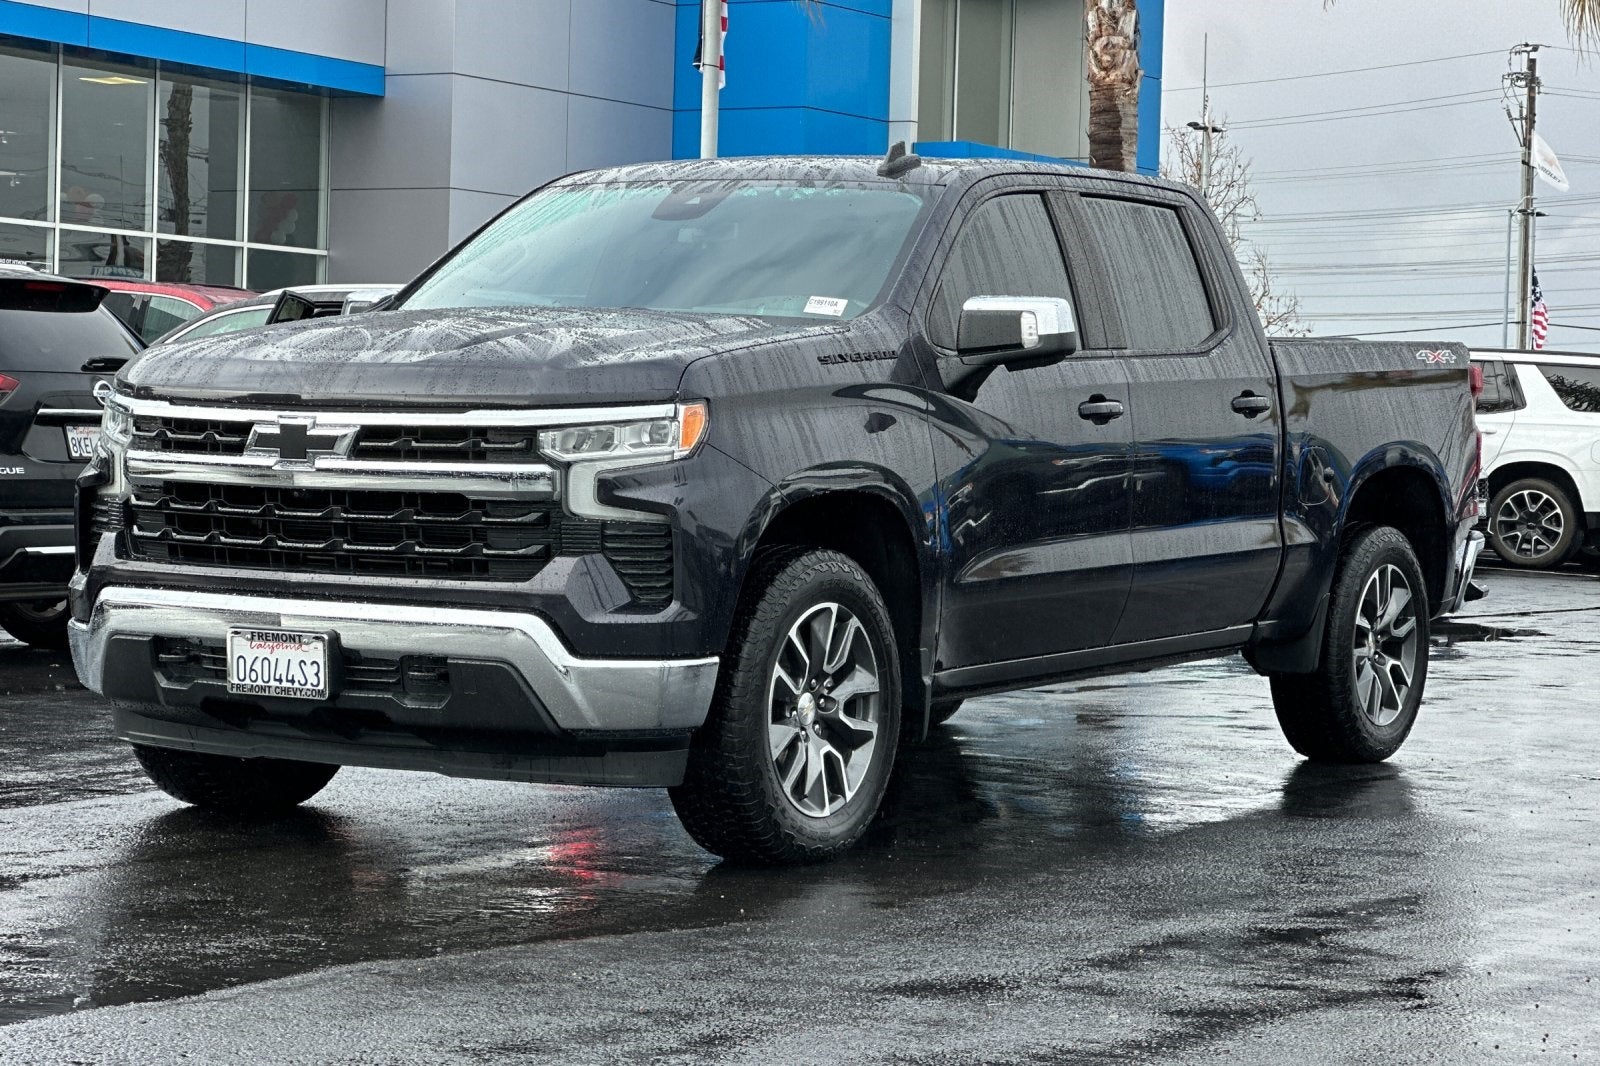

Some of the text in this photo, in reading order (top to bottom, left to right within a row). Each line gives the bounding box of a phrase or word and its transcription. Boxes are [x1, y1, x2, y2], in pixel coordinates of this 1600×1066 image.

[250, 631, 303, 643] FREMONT
[236, 655, 321, 687] 06044S3
[230, 683, 326, 698] FREMONT CHEVY.COM
